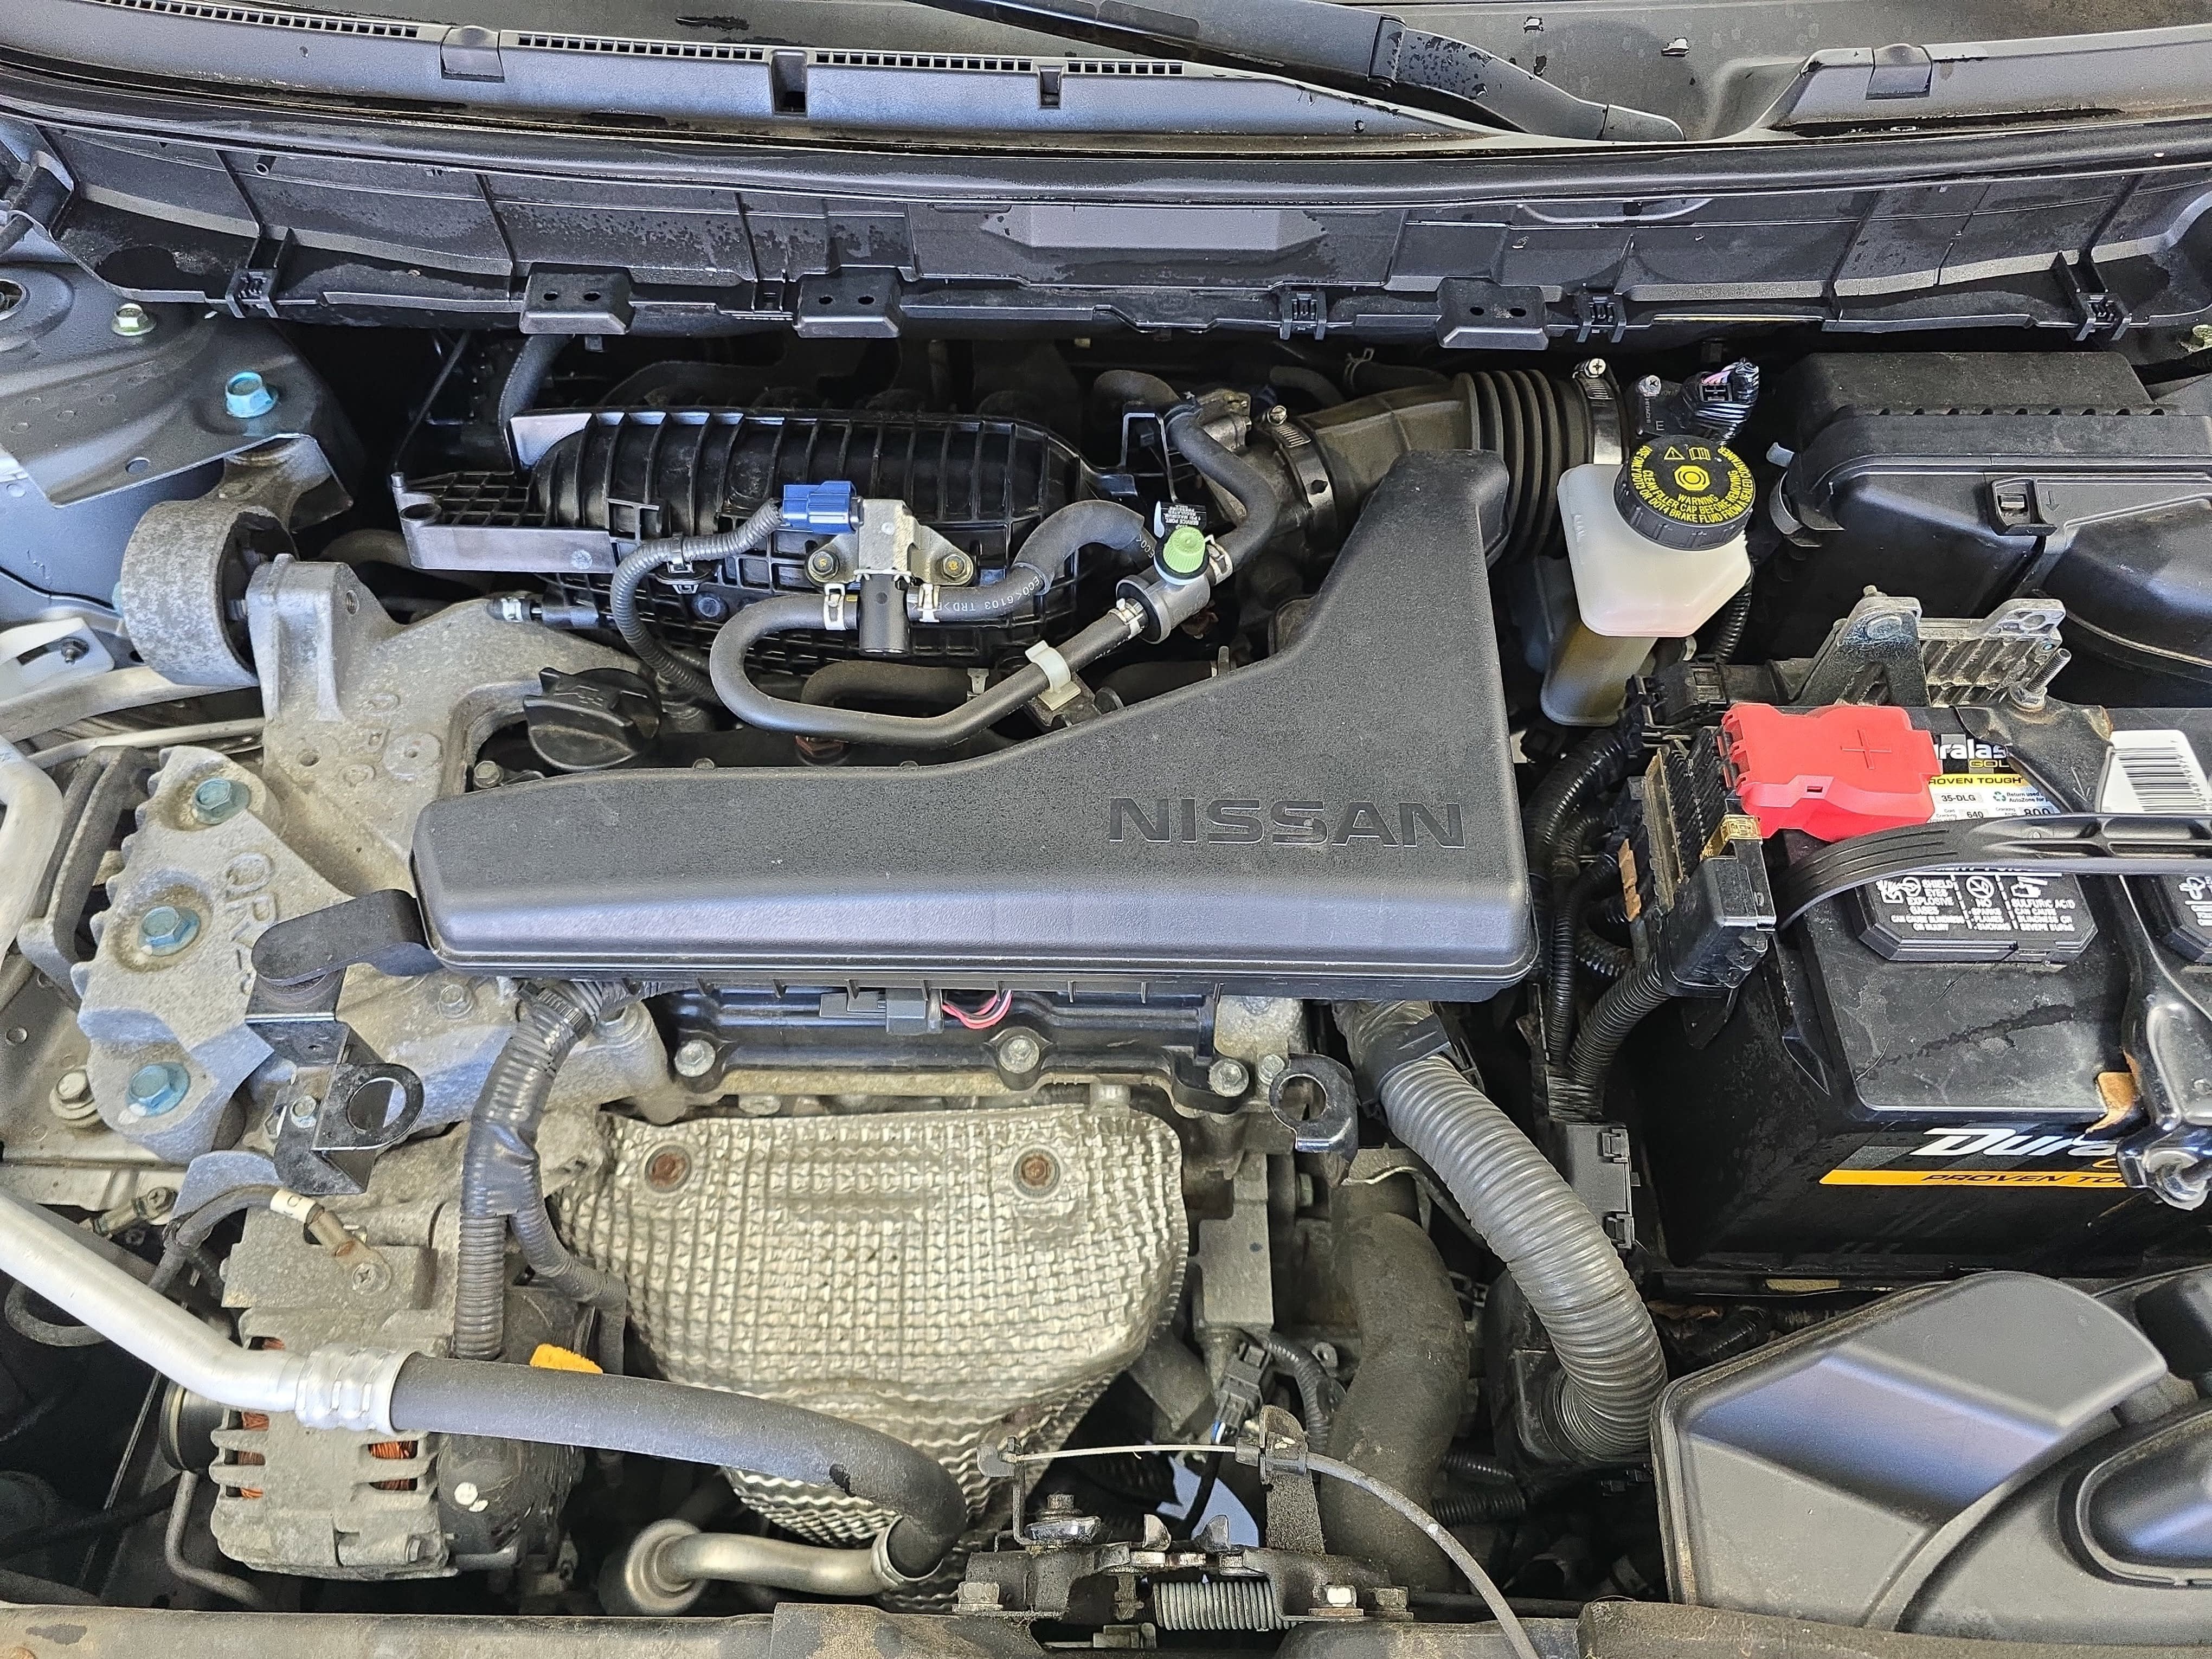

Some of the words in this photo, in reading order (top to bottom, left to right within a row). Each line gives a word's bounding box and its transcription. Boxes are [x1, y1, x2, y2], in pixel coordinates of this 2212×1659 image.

[1636, 446, 1652, 459] USE
[1631, 456, 1645, 473] ONLY
[1718, 446, 1751, 478] CONTAINER
[1639, 489, 1653, 500] OR
[1642, 470, 1659, 491] CLEAN
[1652, 490, 1679, 509] FILLER
[1680, 504, 1697, 513] CAP
[1699, 498, 1732, 514] BEFORE
[1725, 470, 1741, 503] REMOVING
[1739, 479, 1754, 502] SEALED
[1678, 493, 1719, 505] WARNING
[1648, 497, 1670, 514] DOT4
[1721, 503, 1744, 519] FROM
[1669, 509, 1697, 523] BRAKE
[1699, 513, 1723, 523] FLUID
[1969, 759, 2010, 768] GOL
[1109, 797, 1465, 849] NISSAN
[1921, 879, 1953, 889] SHIELD
[1925, 888, 1949, 897] EYES
[1906, 896, 1954, 906] EXPLOSIVE
[1975, 898, 1992, 908] NO
[2011, 898, 2053, 908] SULFURIC
[2054, 899, 2076, 909] ACID
[1909, 906, 1940, 915] GASES
[2014, 908, 2031, 916] CAN
[1908, 1128, 2118, 1156] Dura
[1921, 1174, 2069, 1182] PROVEN
